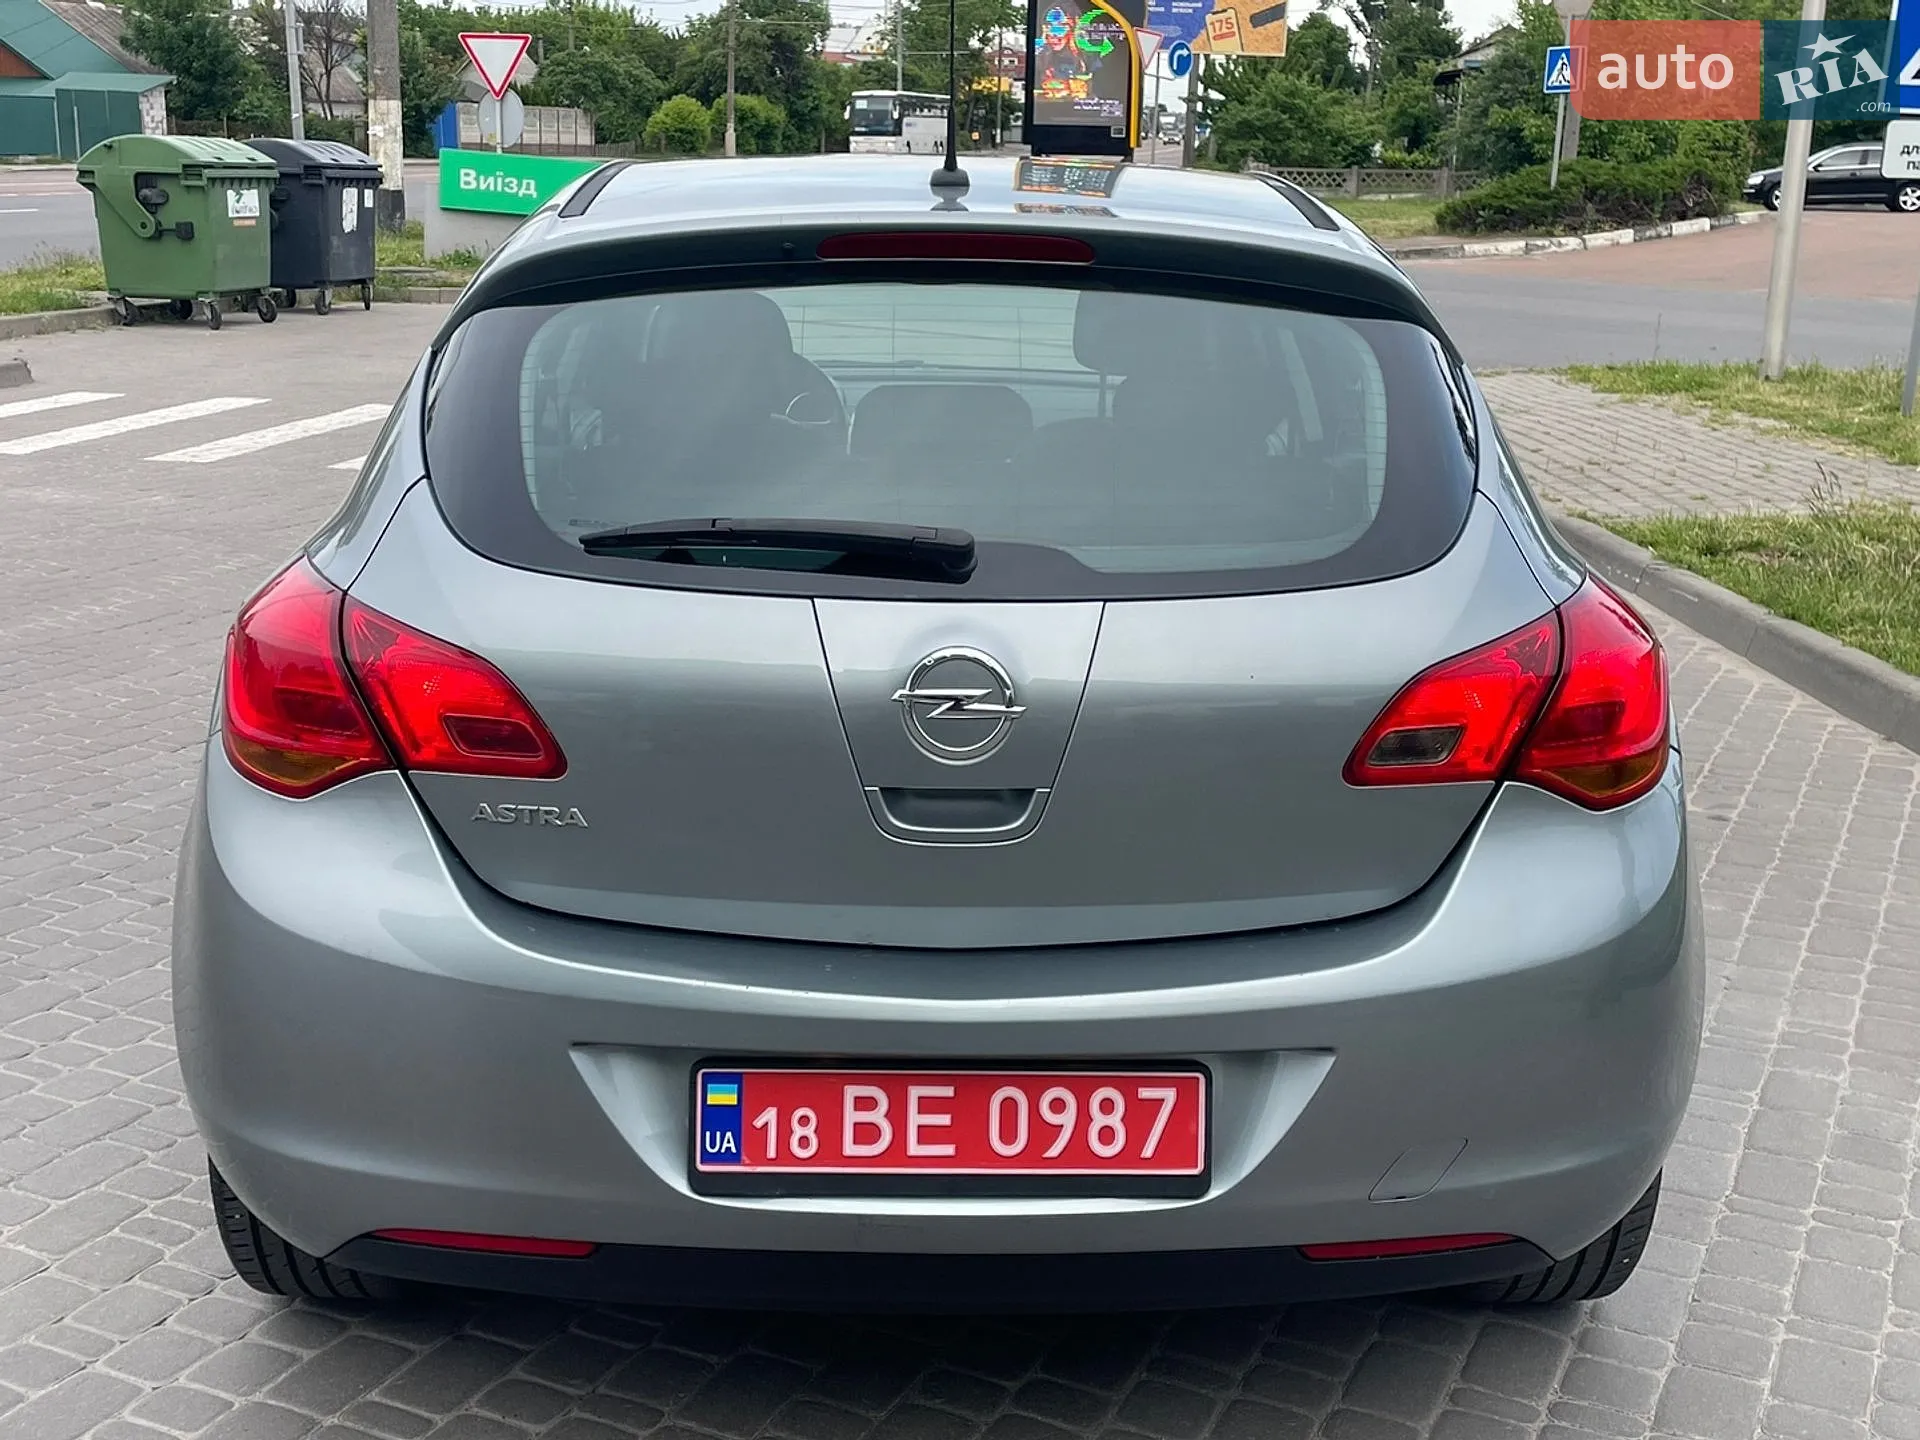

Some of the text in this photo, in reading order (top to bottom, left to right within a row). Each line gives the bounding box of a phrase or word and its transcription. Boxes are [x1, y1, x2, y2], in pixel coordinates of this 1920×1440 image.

[1209, 17, 1234, 33] 175
[459, 168, 537, 198] Виїзд
[471, 803, 588, 827] ASTRA
[752, 1085, 1178, 1158] 18 BE 0987
[705, 1131, 736, 1153] UA
